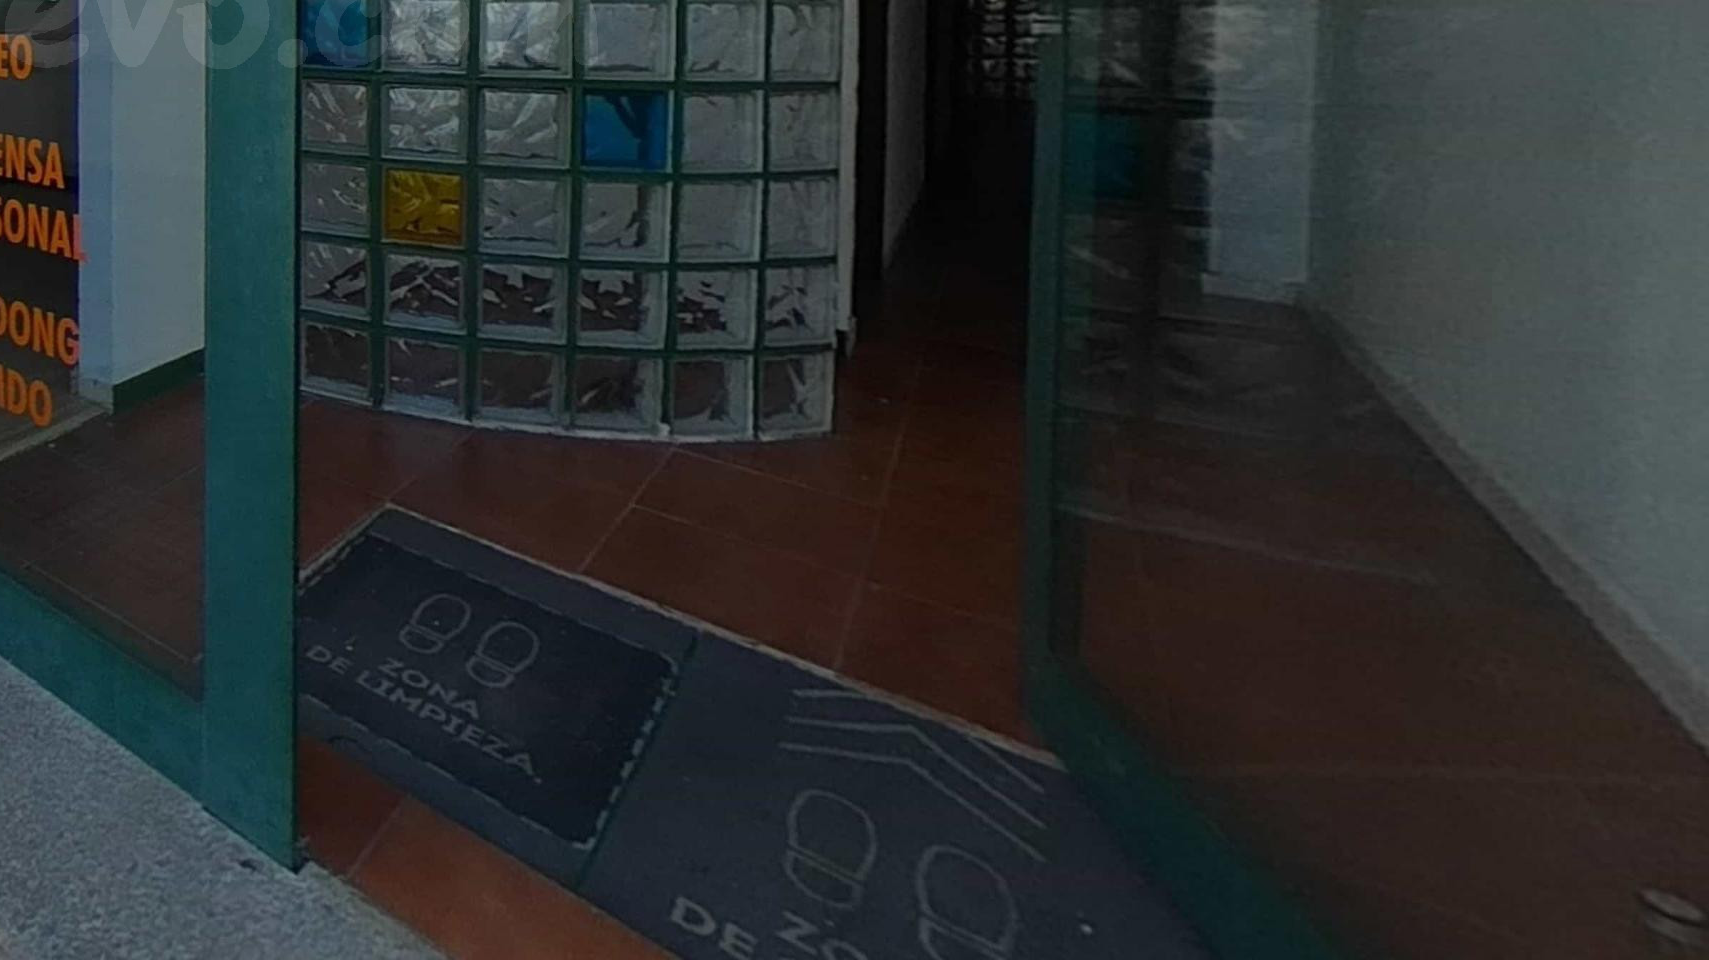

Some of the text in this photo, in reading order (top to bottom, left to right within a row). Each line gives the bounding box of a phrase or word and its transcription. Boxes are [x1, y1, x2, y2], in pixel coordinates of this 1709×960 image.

[304, 644, 535, 777] DE LIMPIEZA
[377, 657, 481, 721] ZONA
[669, 894, 759, 960] DE
